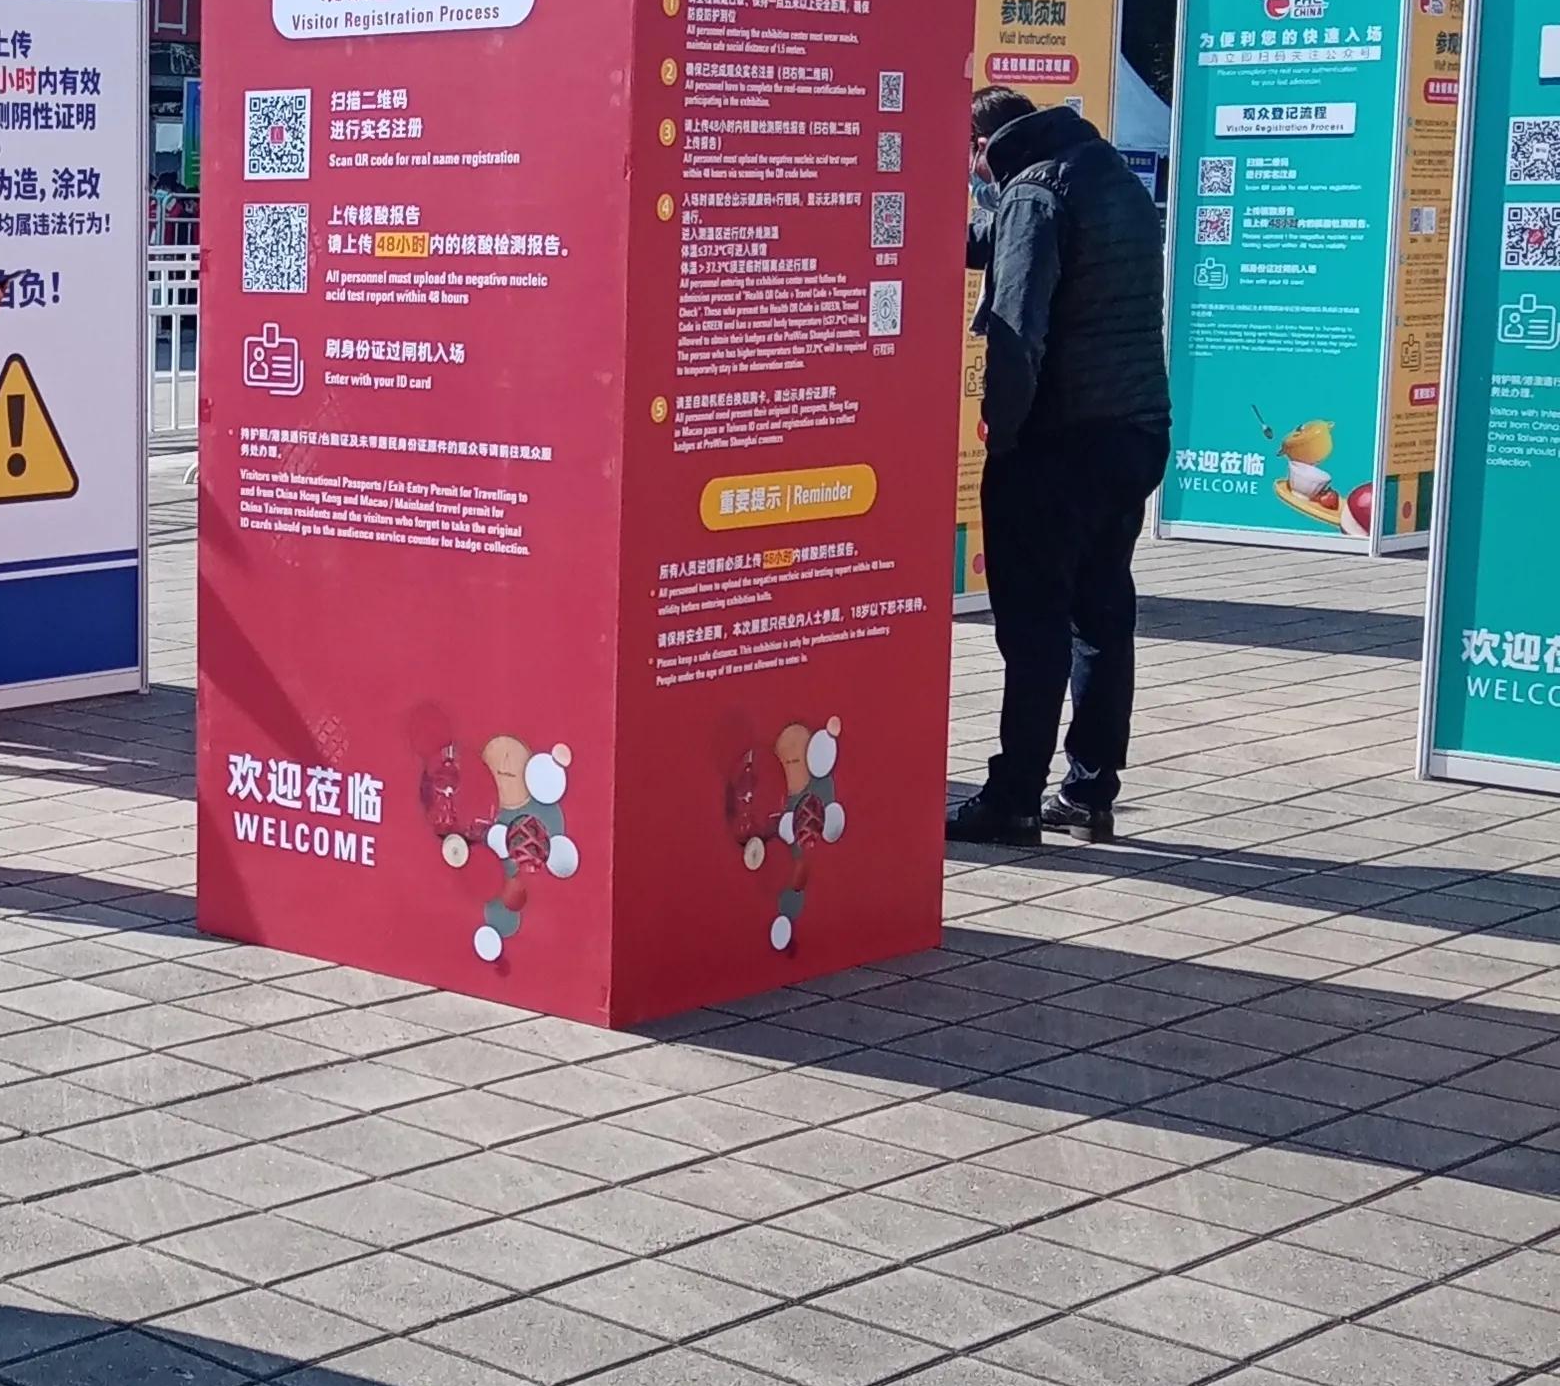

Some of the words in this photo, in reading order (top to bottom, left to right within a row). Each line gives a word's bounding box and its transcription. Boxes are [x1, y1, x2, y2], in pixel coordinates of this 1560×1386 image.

[292, 13, 338, 30] Visitor
[344, 8, 433, 29] Registration
[440, 5, 498, 21] Process
[1294, 7, 1323, 17] CHINA
[999, 31, 1016, 43] Visit
[1018, 32, 1065, 45] Instructions
[1200, 25, 1382, 49] 为便利您的快速入场
[330, 88, 408, 112] 扫描二维码
[1242, 105, 1328, 121] 观众登记流程
[329, 117, 424, 141] 进行实名注册
[1226, 124, 1252, 132] Visitor
[1255, 123, 1308, 135] Registration
[1310, 123, 1344, 133] Process
[329, 153, 352, 166] Scan
[354, 153, 368, 166] QR
[370, 153, 393, 165] code
[395, 152, 409, 165] for
[411, 152, 430, 165] real
[432, 154, 459, 164] name
[461, 150, 519, 166] registration
[328, 205, 420, 226] 上传核酸报告
[325, 269, 339, 282] All
[340, 271, 386, 285] personnel
[388, 272, 411, 283] must
[413, 271, 446, 287] upload
[447, 271, 463, 284] the
[465, 273, 507, 287] negative
[509, 273, 547, 286] nucleic
[325, 288, 345, 300] acid
[346, 289, 364, 301] test
[366, 290, 394, 304] report
[395, 289, 426, 302] within
[428, 290, 439, 302] 48
[441, 290, 468, 303] hours
[324, 338, 466, 364] 刷身份证过闸机入场
[324, 371, 348, 384] Enter
[350, 373, 371, 385] with
[373, 377, 394, 388] your
[396, 374, 407, 387] ID
[409, 376, 431, 388] card
[1175, 449, 1266, 476] 欢迎莅临
[240, 468, 270, 481] Visitors
[271, 471, 289, 482] with
[290, 472, 340, 486] International
[342, 476, 381, 491] Passports
[388, 480, 404, 492] Exit
[406, 481, 428, 496] Entry
[430, 483, 458, 496] Permit
[459, 486, 472, 497] for
[473, 487, 516, 504] Travelling
[518, 492, 527, 502] to
[1178, 477, 1259, 495] WELCOME
[719, 485, 782, 516] 重要提示
[793, 481, 853, 506] Reminder
[227, 752, 384, 824] 欢迎莅临
[233, 811, 377, 867] WELCOME
